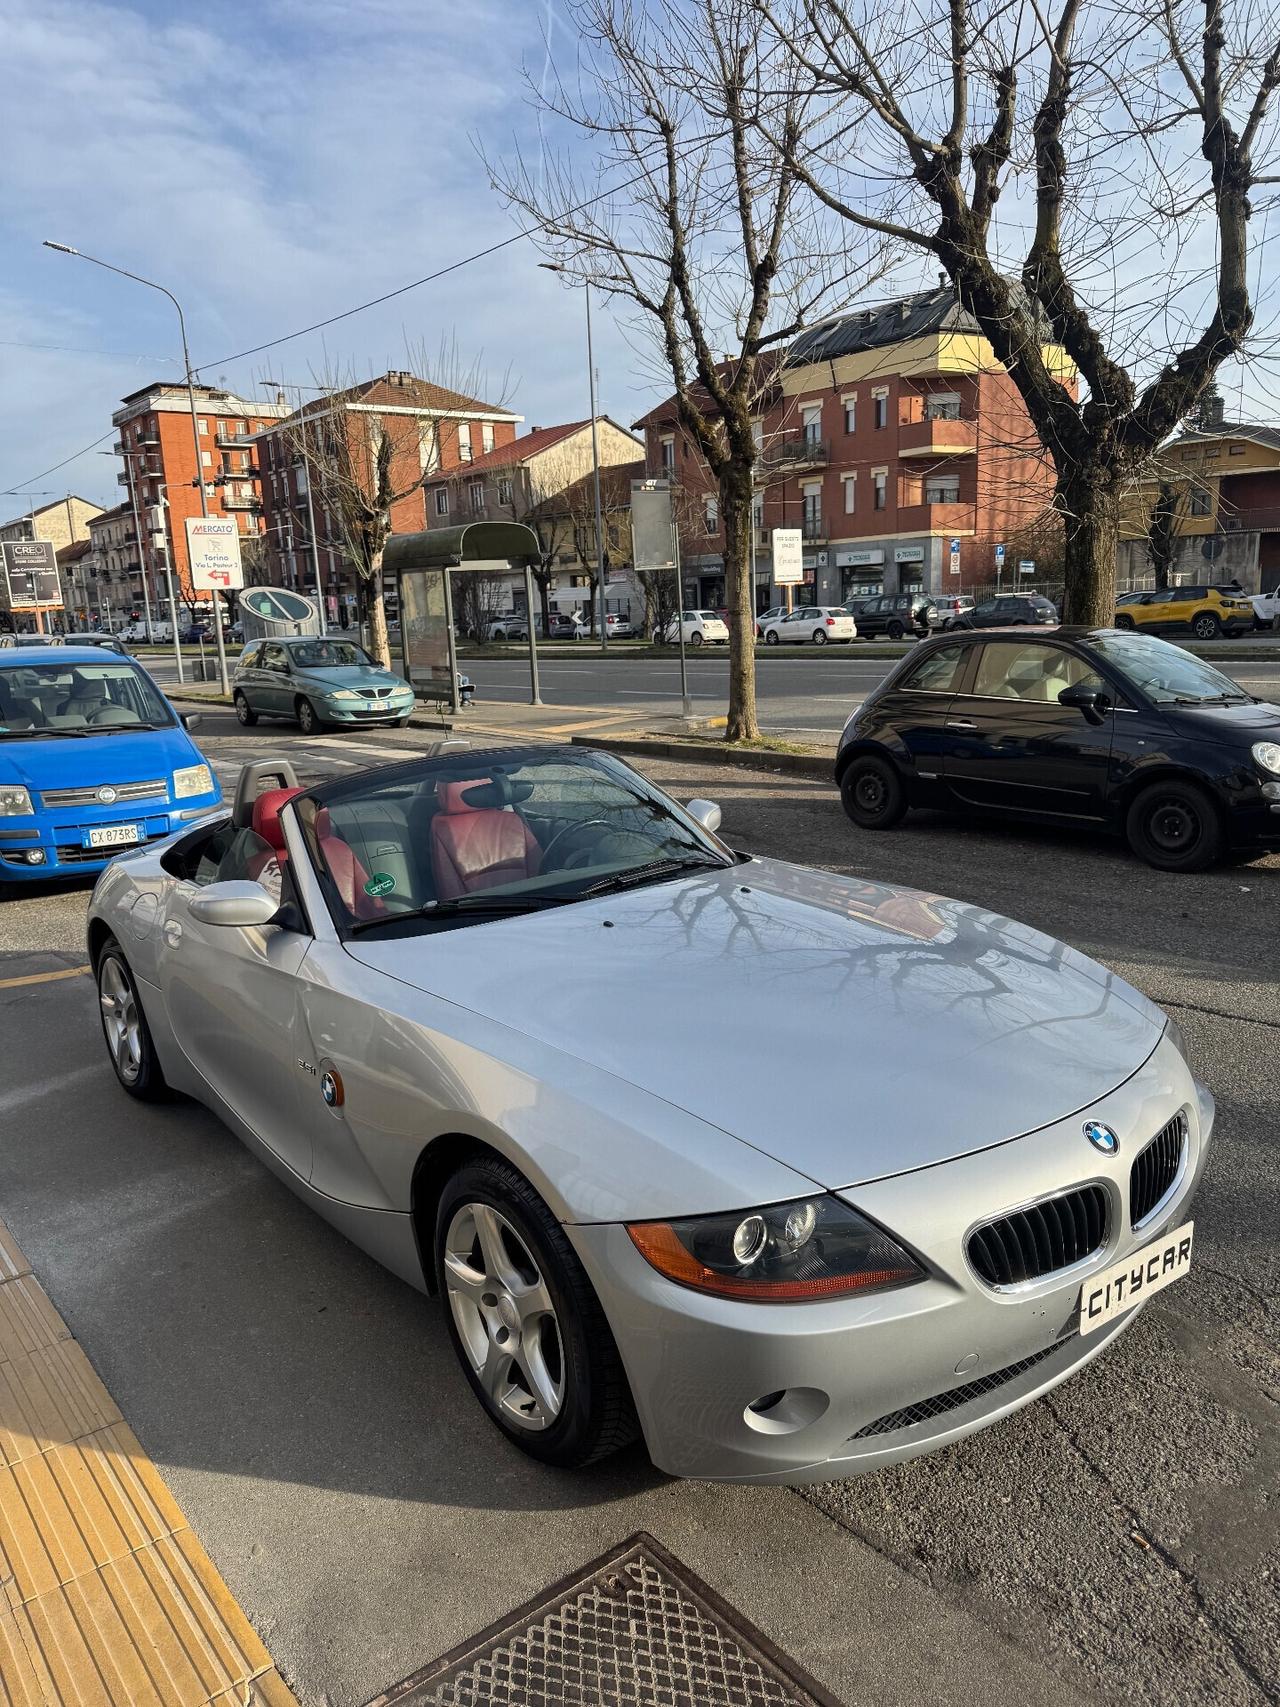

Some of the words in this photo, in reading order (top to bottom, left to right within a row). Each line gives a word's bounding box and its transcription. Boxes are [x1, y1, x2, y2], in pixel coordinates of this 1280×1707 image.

[192, 525, 234, 534] MERCATO
[14, 546, 43, 554] CREO
[997, 546, 1003, 555] P
[91, 831, 105, 844] CX
[106, 827, 137, 842] 873RS
[1088, 1237, 1192, 1319] CITYCAR
